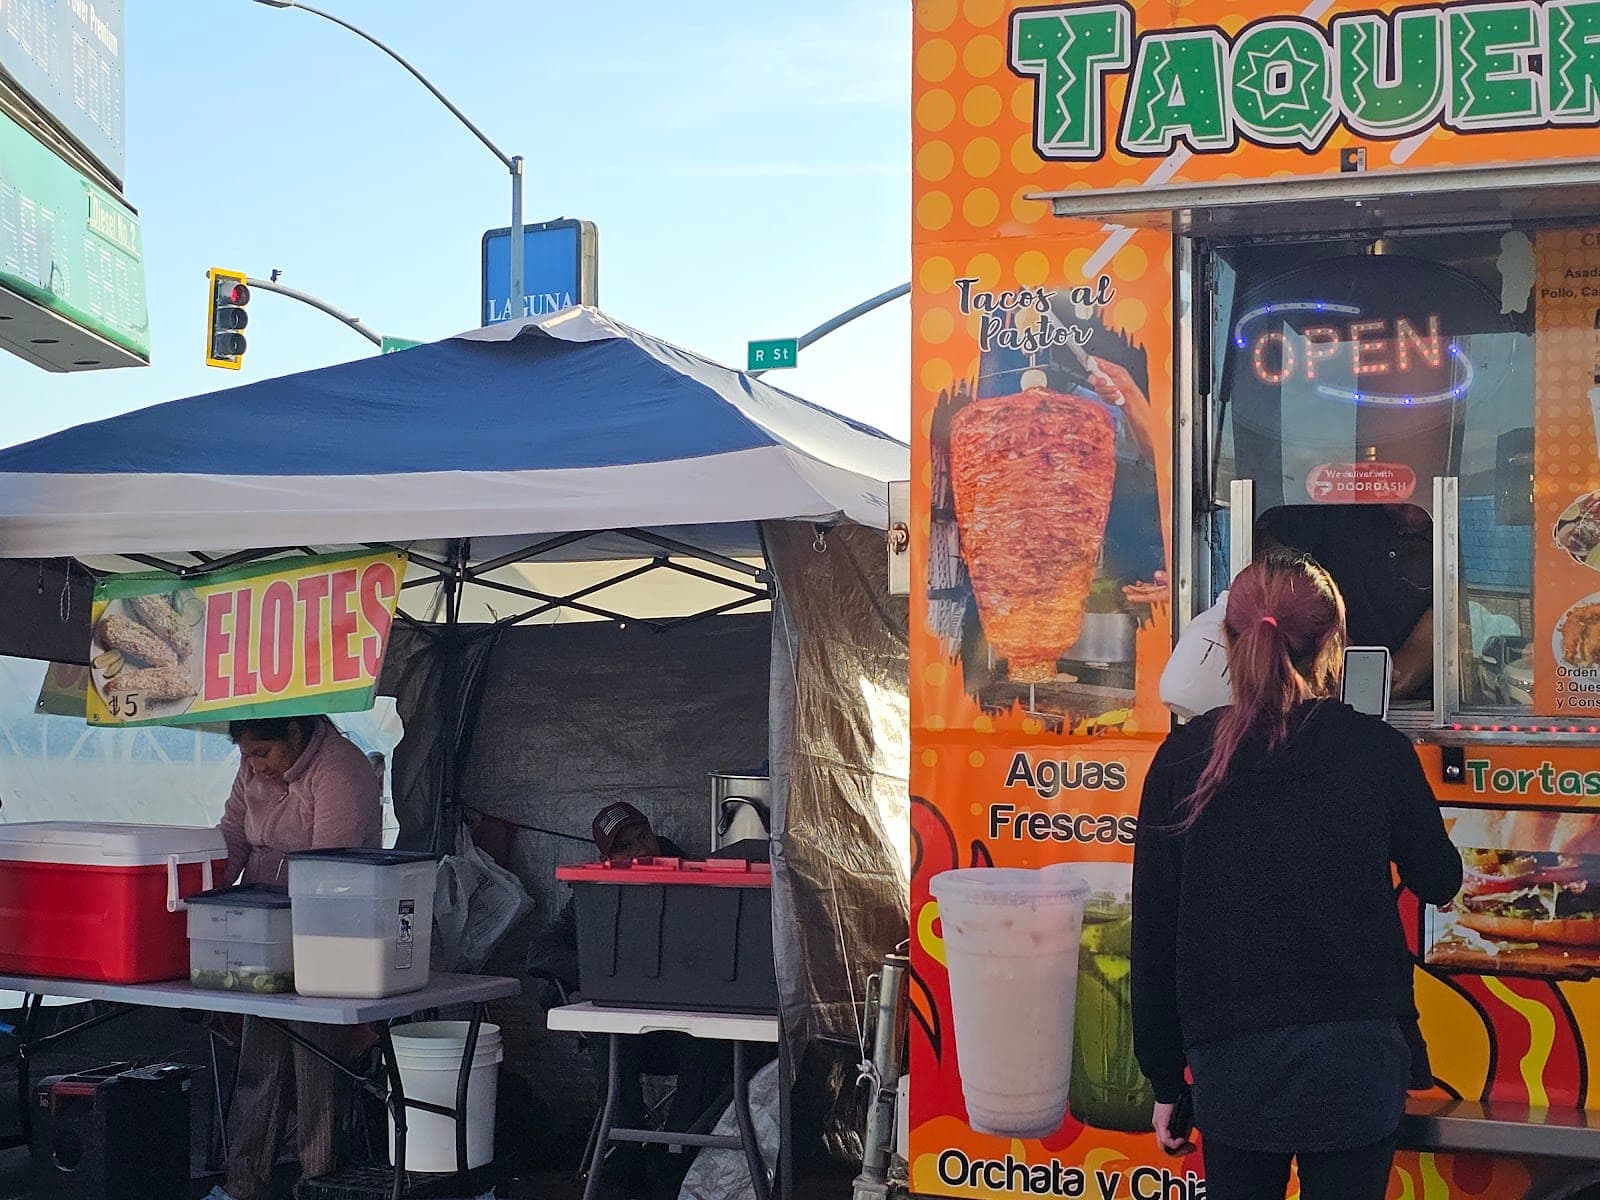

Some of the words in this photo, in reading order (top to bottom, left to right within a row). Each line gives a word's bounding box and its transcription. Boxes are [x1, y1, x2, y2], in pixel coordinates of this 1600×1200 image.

[92, 193, 116, 238] Diesel
[130, 221, 137, 251] 2
[954, 277, 1057, 314] Tacos
[1070, 274, 1116, 307] al
[1541, 287, 1578, 299] Pollo,
[979, 314, 1094, 352] Pastor
[1254, 315, 1441, 384] OPEN
[756, 350, 765, 361] R
[773, 348, 789, 360] St
[1326, 471, 1340, 479] We
[1342, 469, 1374, 479] deliver
[1375, 469, 1393, 478] with
[1337, 482, 1407, 491] DOORDASH
[203, 562, 397, 702] ELOTES
[1557, 666, 1598, 677] Orden
[1557, 681, 1564, 692] 3
[1556, 698, 1564, 709] y
[1005, 751, 1126, 799] Aguas
[1466, 760, 1600, 796] Tortas
[989, 803, 1138, 845] Frescas
[937, 1148, 1084, 1198] Orchata
